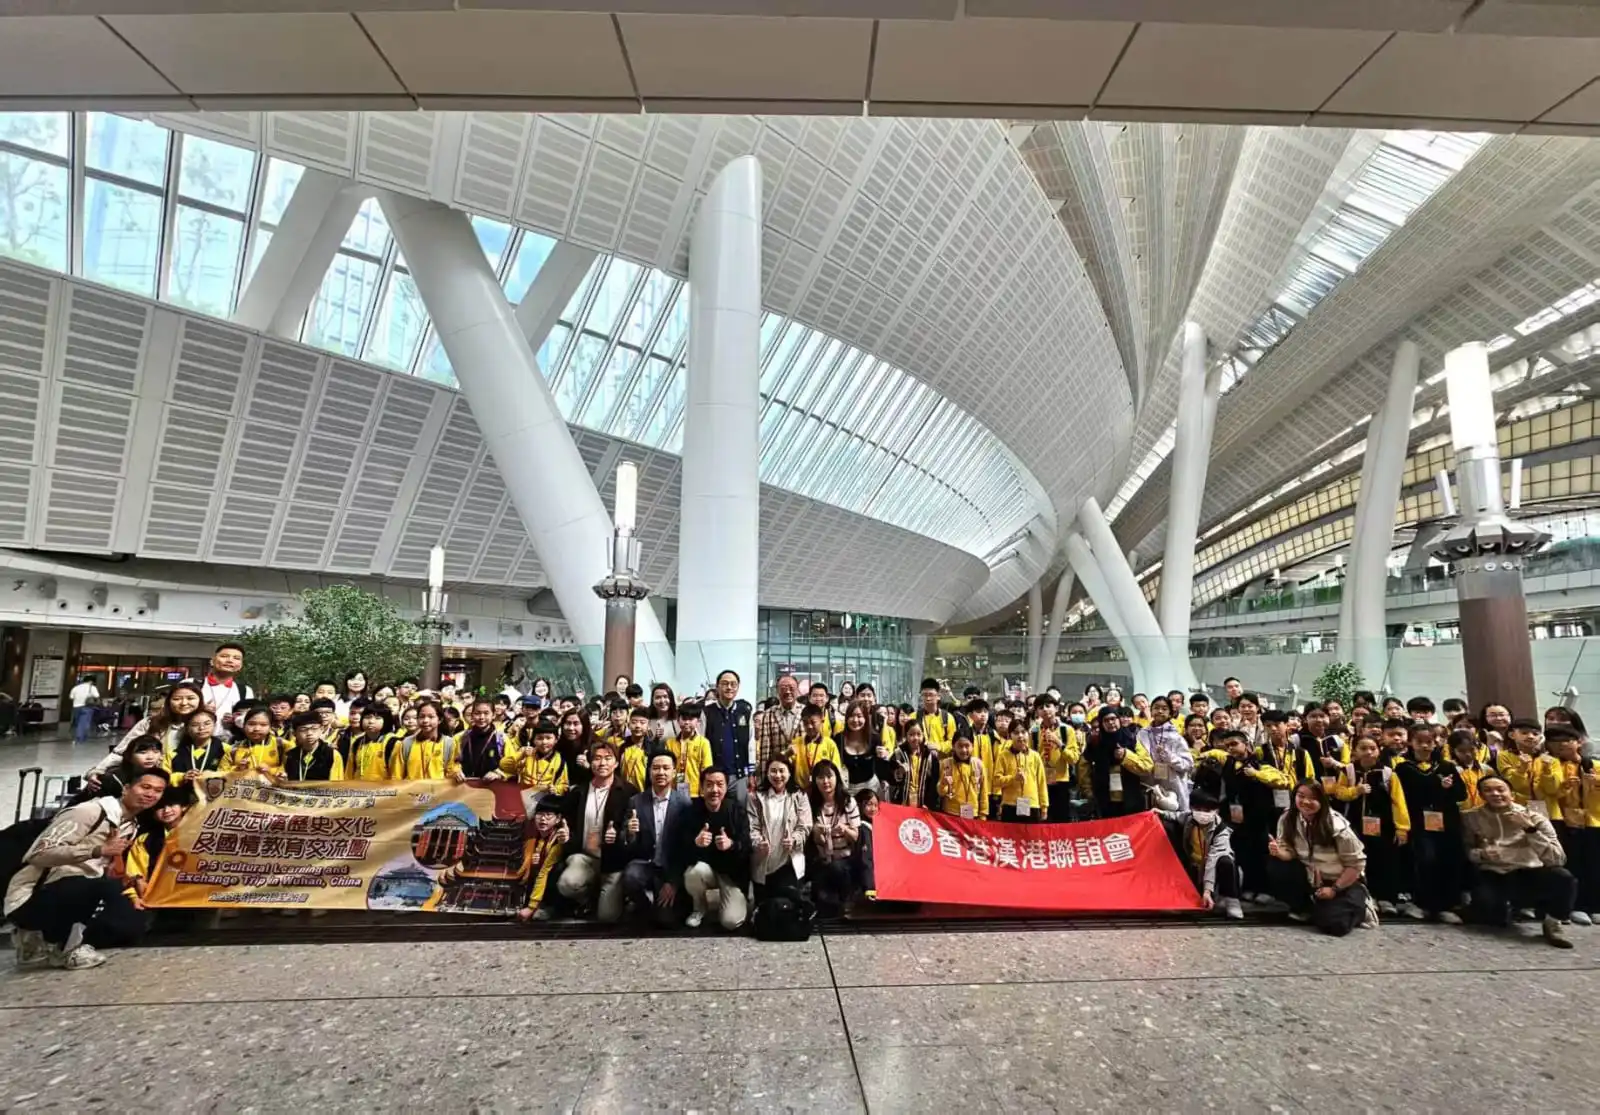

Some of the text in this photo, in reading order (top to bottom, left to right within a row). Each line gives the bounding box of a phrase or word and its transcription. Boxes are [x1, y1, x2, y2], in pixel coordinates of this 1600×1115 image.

[203, 808, 376, 837] 小五武漢歷史文化
[191, 831, 371, 860] 及國情教育交流團
[936, 827, 1134, 870] 香港漢港聯誼會
[176, 872, 362, 887] Exchange Trip in Wuhan, China
[197, 860, 350, 876] P.5 Cultural Learning and
